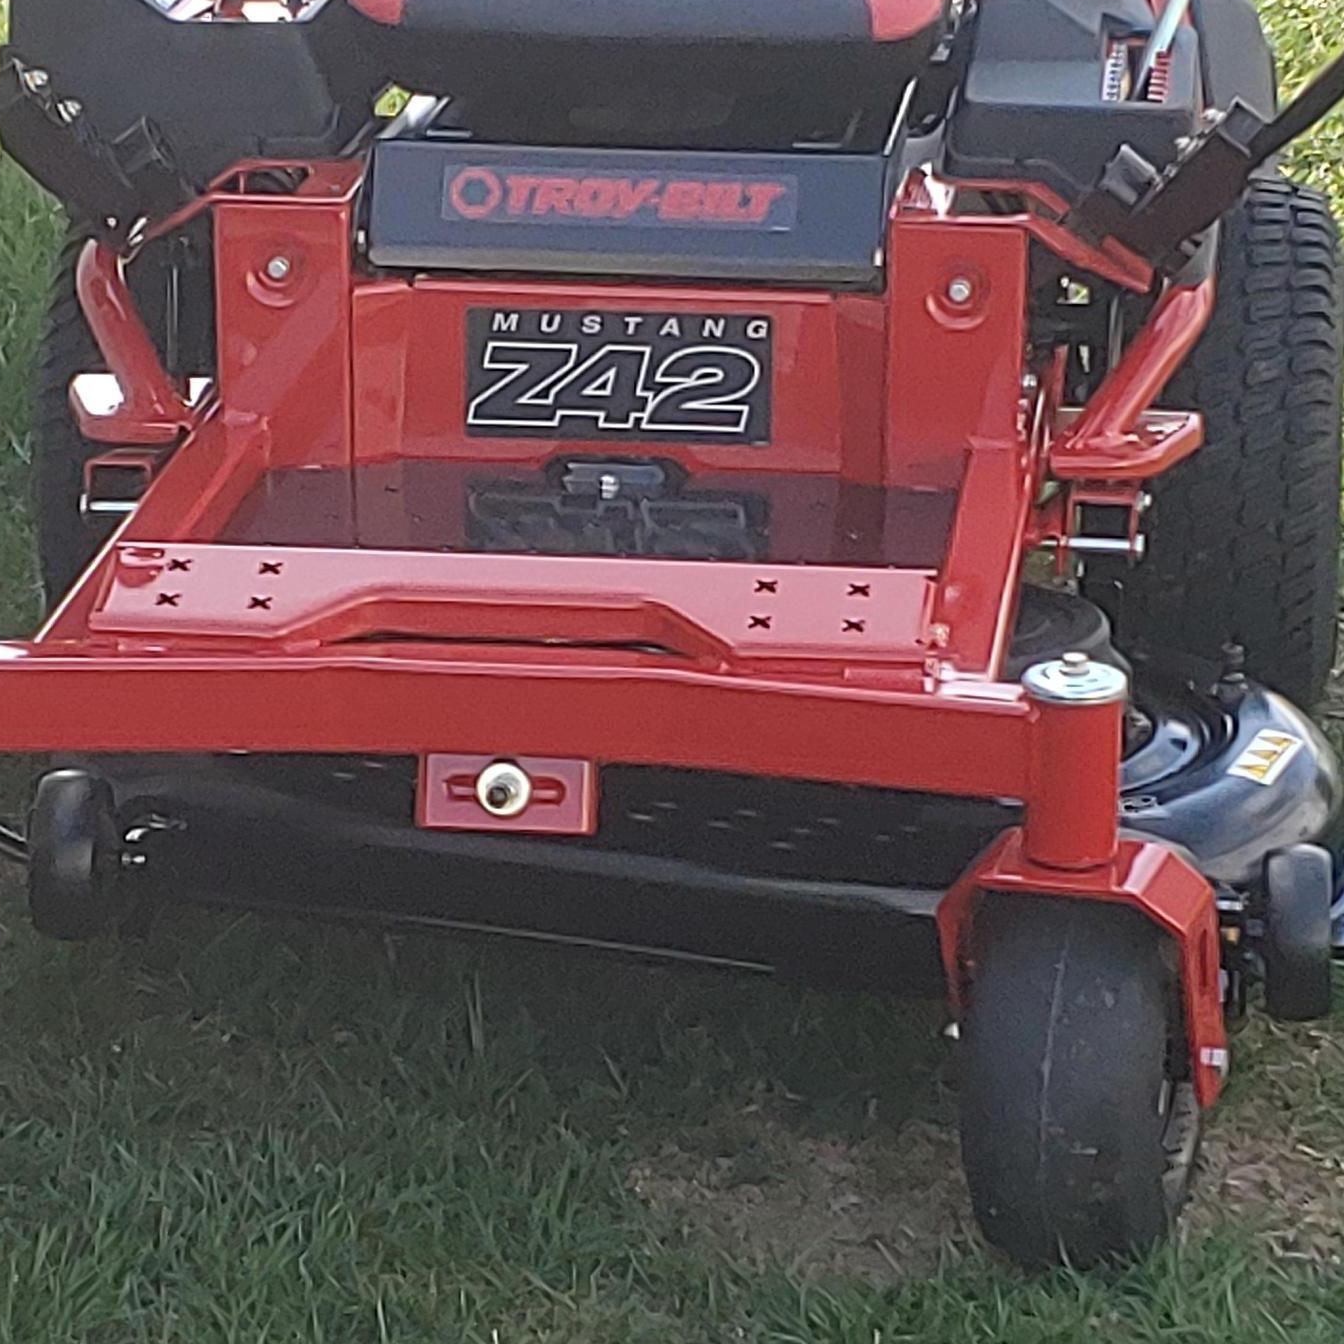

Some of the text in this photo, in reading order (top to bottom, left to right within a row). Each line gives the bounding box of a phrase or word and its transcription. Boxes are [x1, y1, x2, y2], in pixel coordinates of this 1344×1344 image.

[505, 174, 786, 224] TROY-BILT
[491, 312, 770, 339] MUSTANG
[466, 342, 761, 433] Z42
